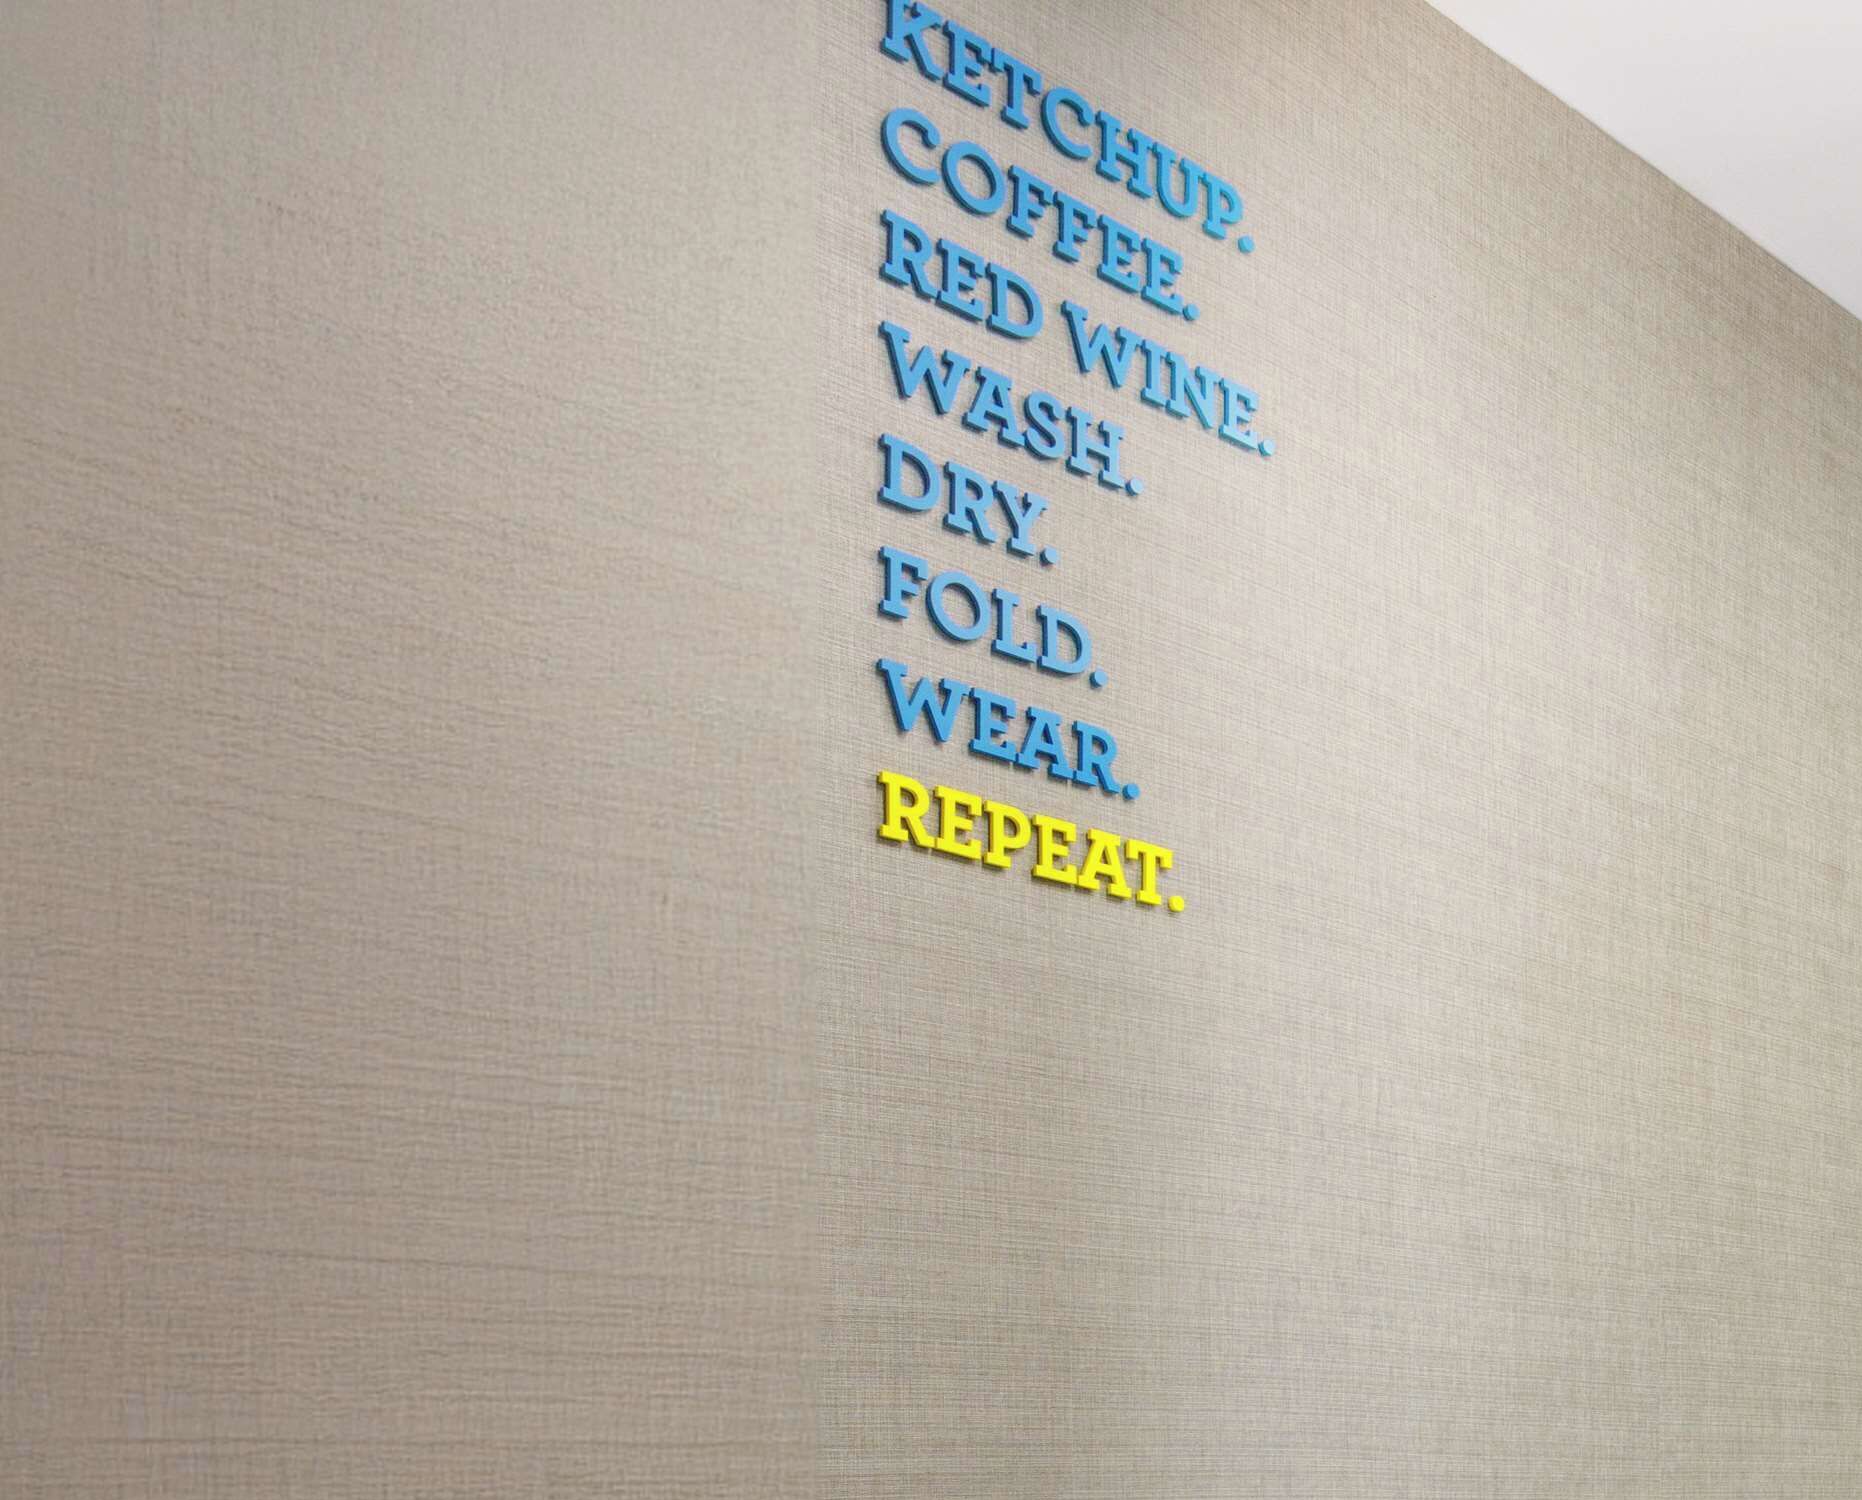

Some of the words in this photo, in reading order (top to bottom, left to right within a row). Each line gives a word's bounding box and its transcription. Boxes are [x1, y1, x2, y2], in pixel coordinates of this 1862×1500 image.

[879, 0, 1256, 254] KETCHUP.
[880, 107, 1200, 322] COFFEE.
[878, 320, 1144, 496] WASH.
[879, 208, 1045, 340] RED
[1060, 300, 1276, 457] WINE.
[877, 432, 1060, 566] DRY.
[877, 545, 1109, 688] FOLD.
[876, 658, 1141, 800] WEAR.
[876, 770, 1186, 913] REPEAT.
